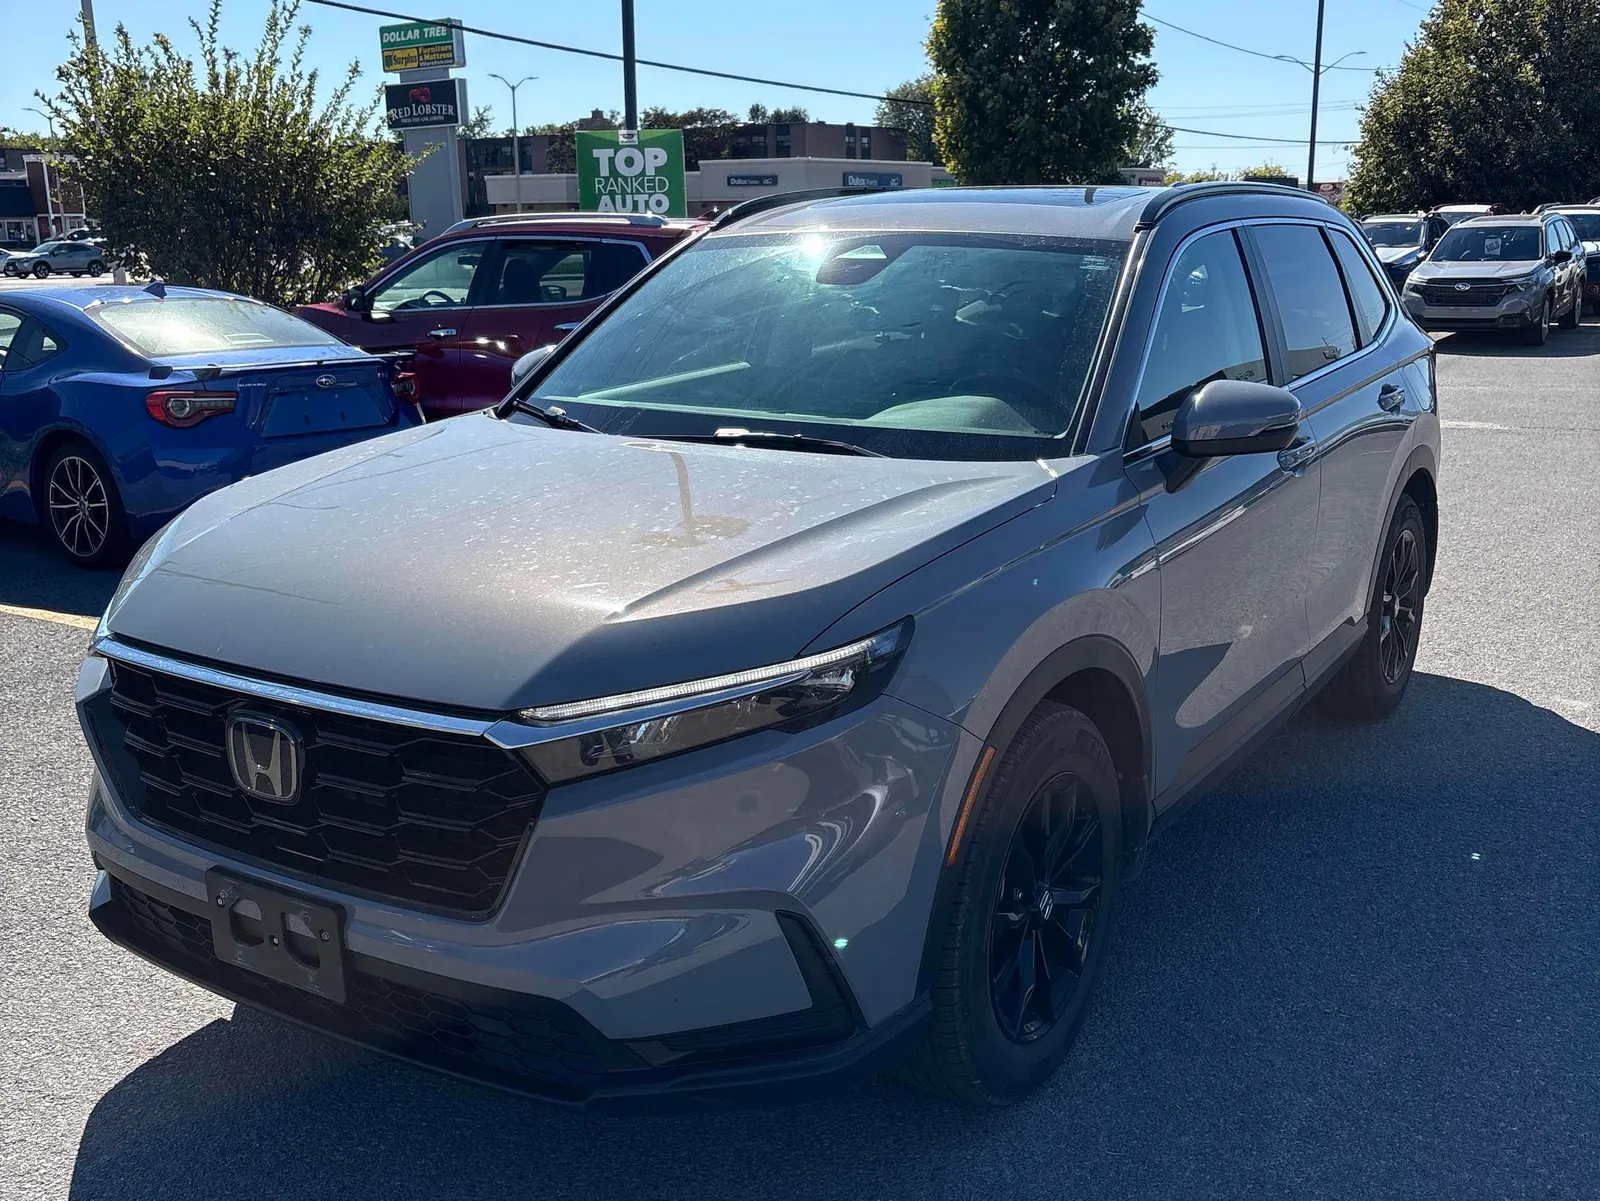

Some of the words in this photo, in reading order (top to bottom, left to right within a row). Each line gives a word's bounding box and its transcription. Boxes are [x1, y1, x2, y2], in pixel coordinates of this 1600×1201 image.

[382, 29, 420, 43] DOLLAR
[423, 27, 447, 38] TREE
[419, 45, 452, 54] Furniture
[423, 52, 453, 60] Mattress
[391, 107, 414, 121] RED
[412, 103, 455, 116] LOBSTER
[592, 147, 668, 177] TOP
[595, 176, 669, 194] RANKED
[730, 177, 748, 185] Dulux
[848, 175, 866, 186] Dulux
[597, 193, 670, 214] AUTO
